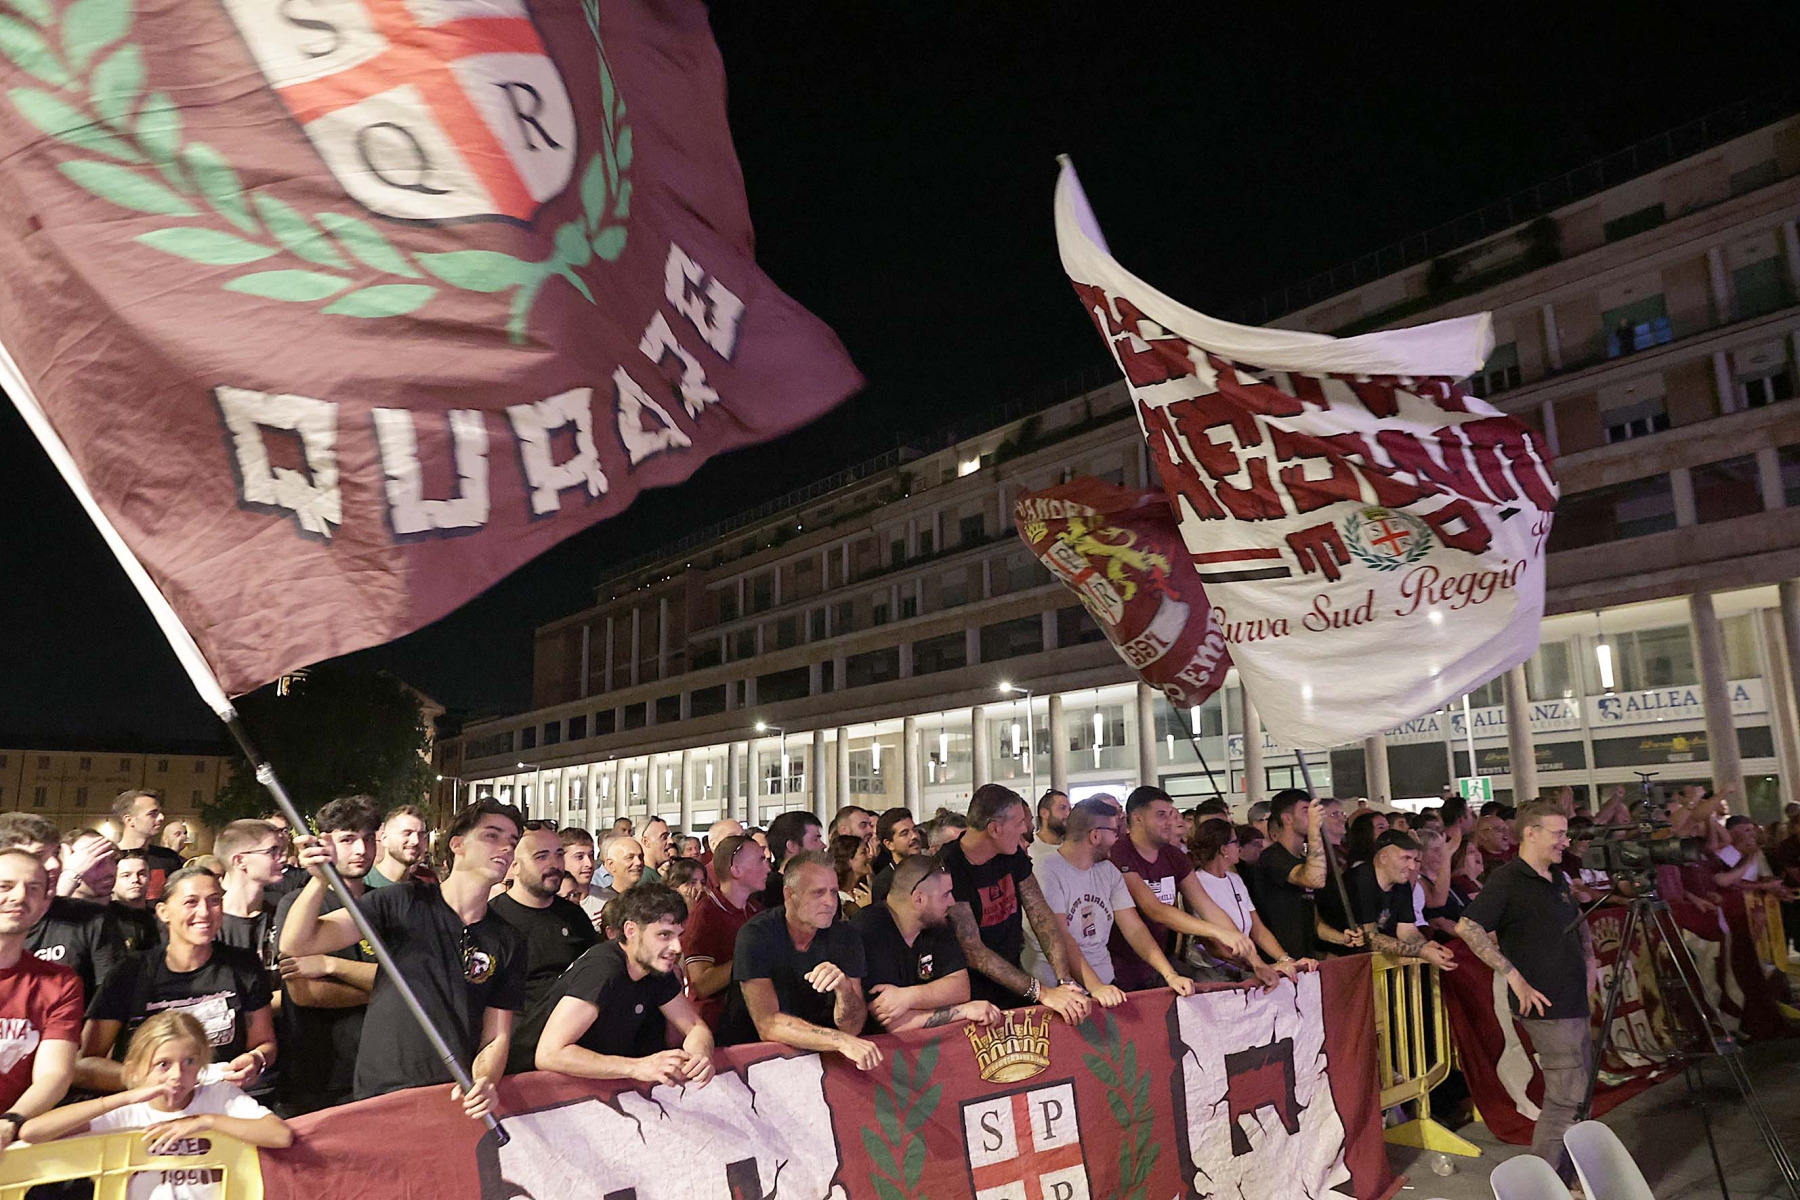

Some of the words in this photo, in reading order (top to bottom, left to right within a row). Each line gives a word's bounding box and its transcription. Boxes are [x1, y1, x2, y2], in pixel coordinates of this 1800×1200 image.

[490, 82, 564, 152] R
[1303, 589, 1374, 632] Sud
[1474, 703, 1577, 727] ALLNZA
[1626, 685, 1751, 712] ALLEAA
[980, 1109, 1003, 1154] S
[1037, 1098, 1064, 1142] P
